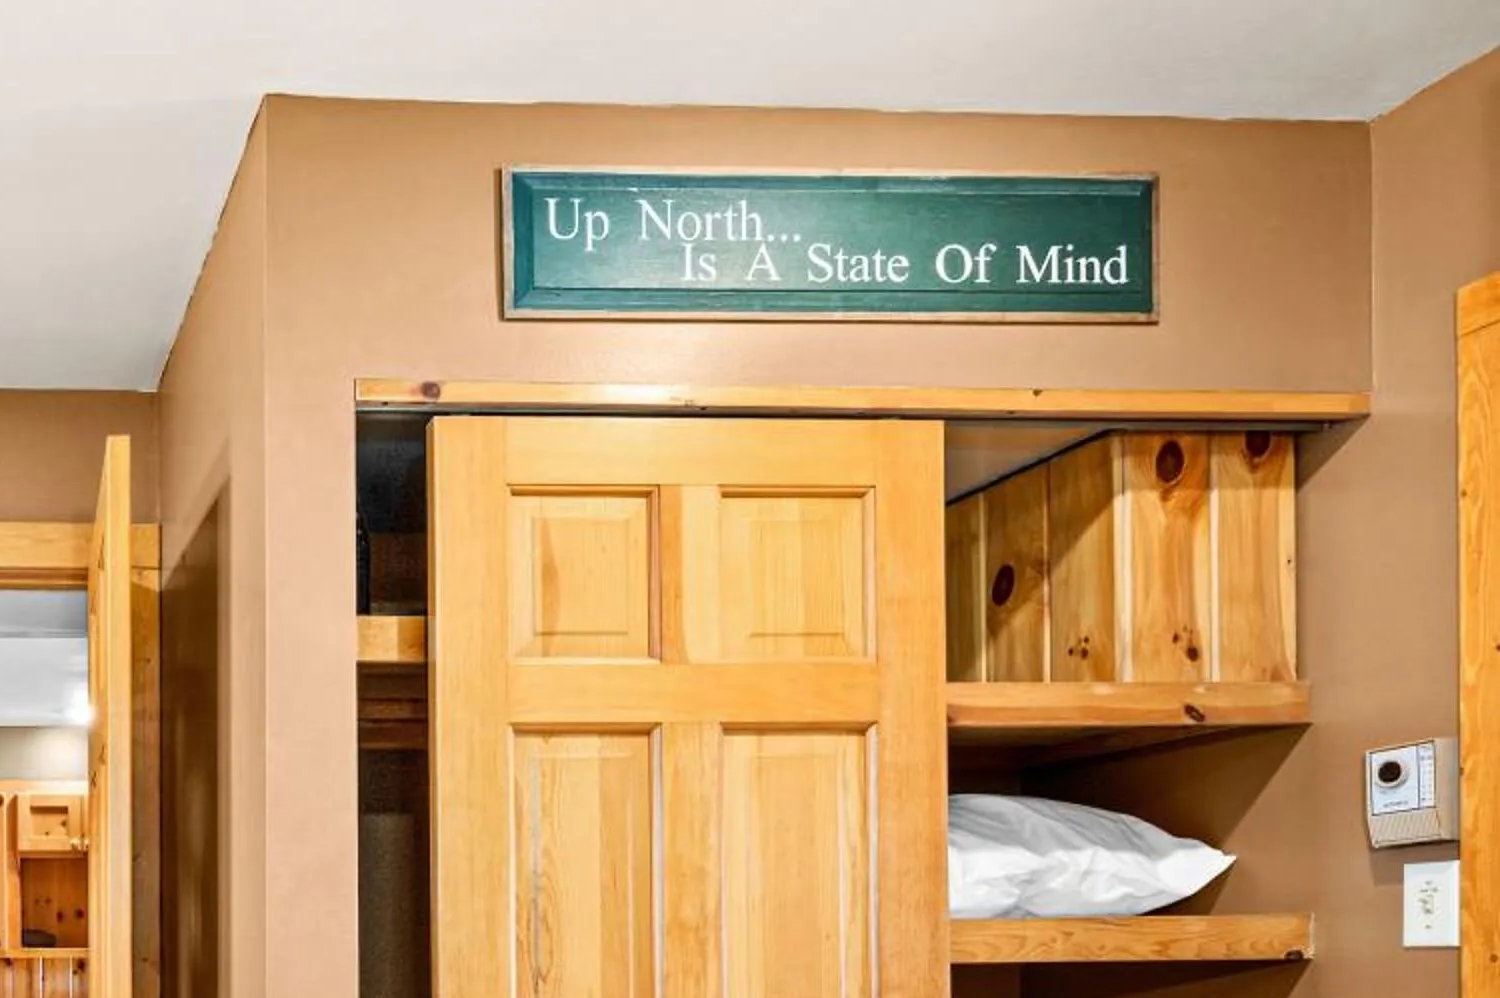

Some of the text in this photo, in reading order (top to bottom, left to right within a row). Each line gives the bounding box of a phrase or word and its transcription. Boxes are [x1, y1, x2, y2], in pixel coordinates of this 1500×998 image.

[544, 197, 802, 252] Up North...
[680, 241, 1130, 285] Is A State Of Mind
